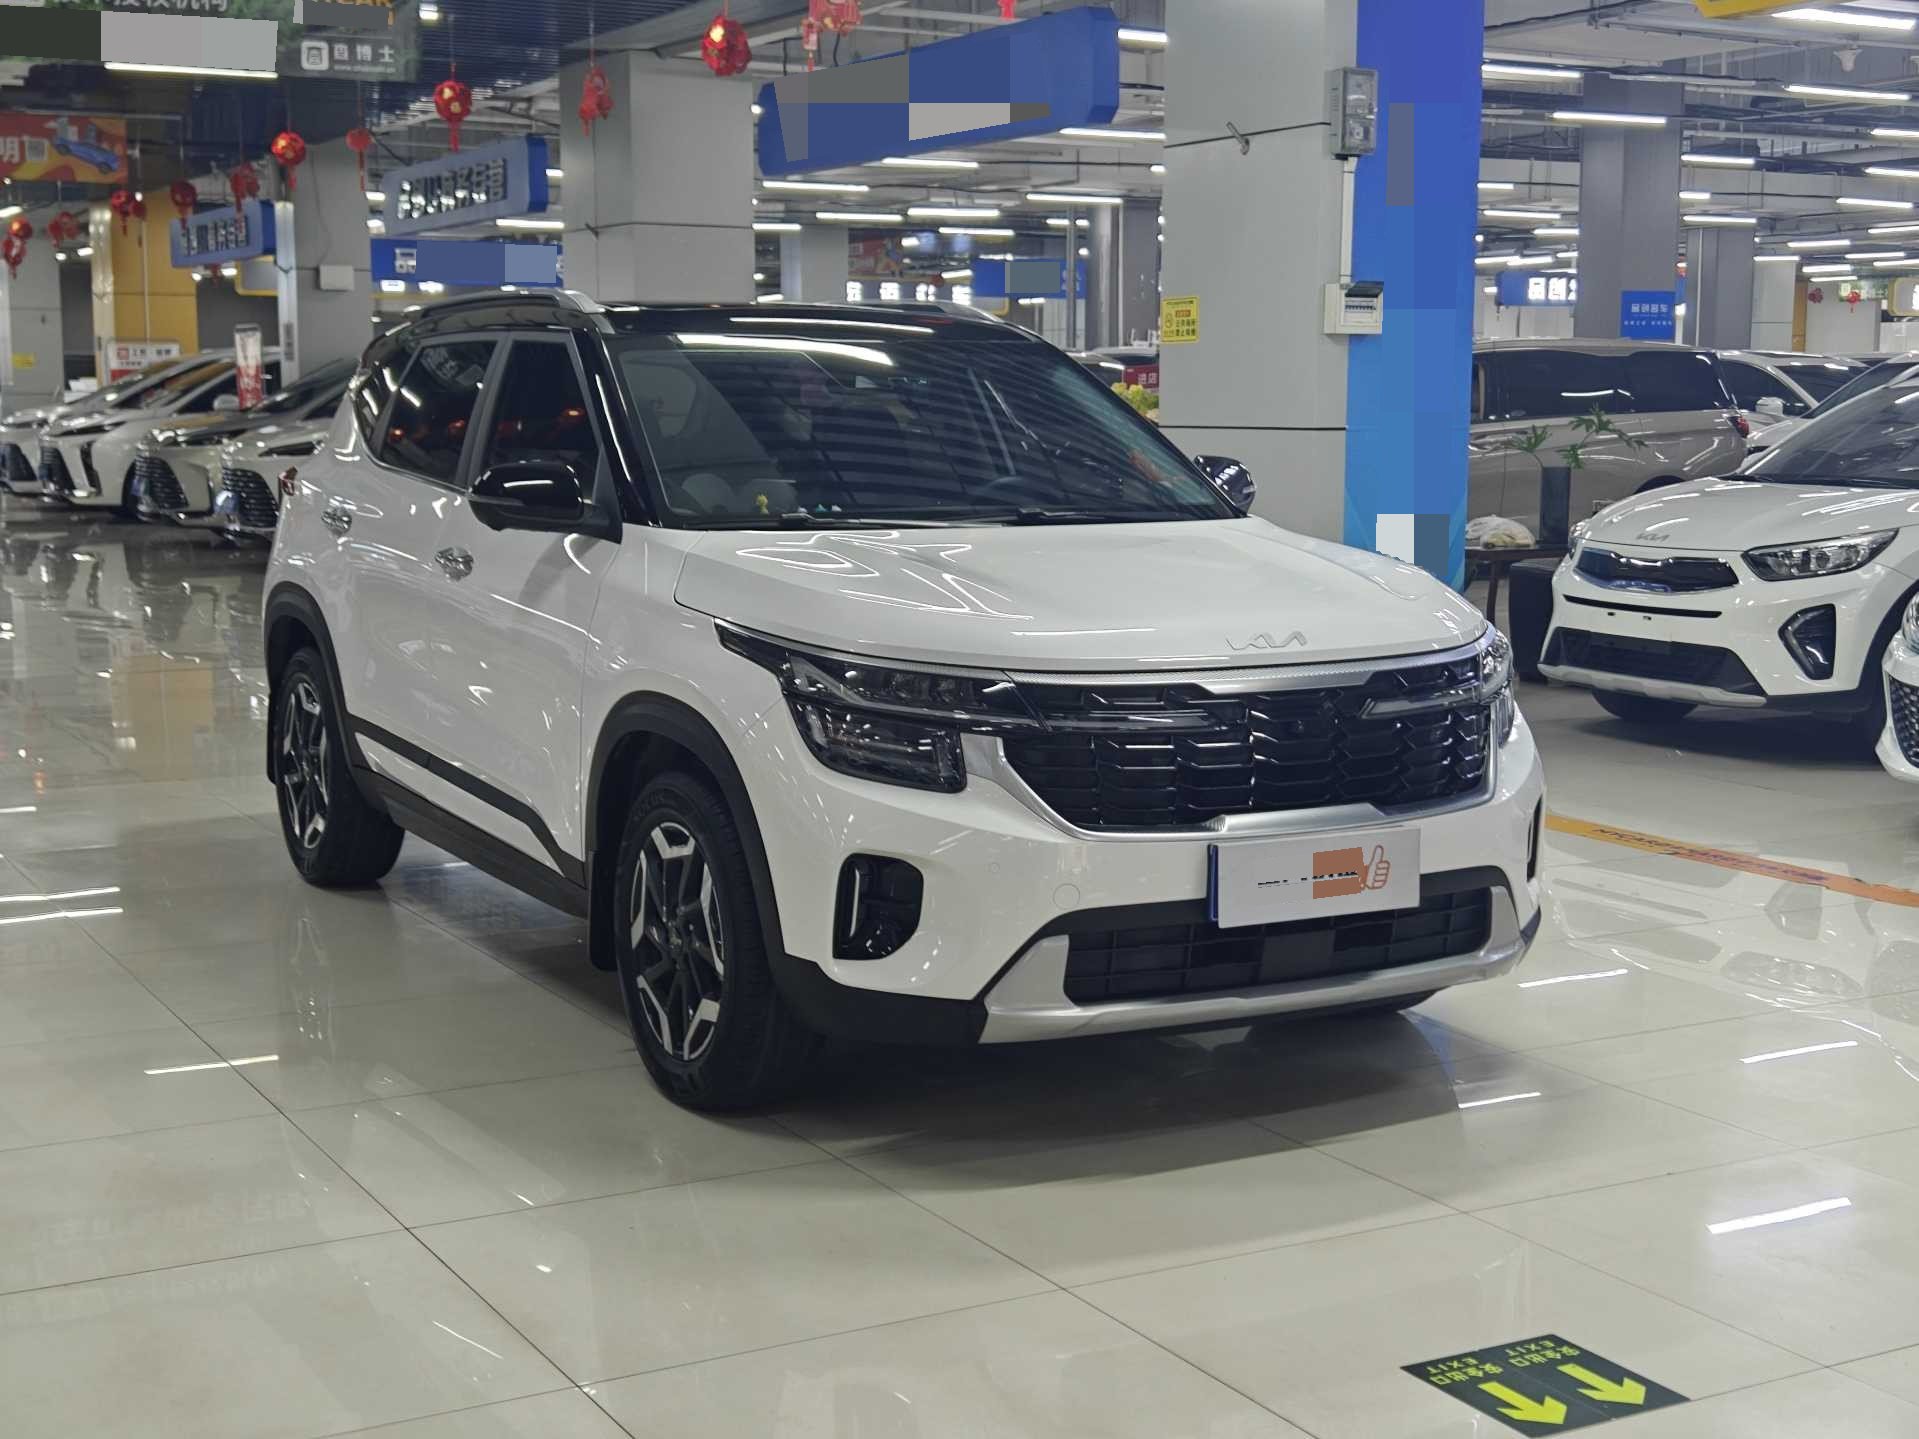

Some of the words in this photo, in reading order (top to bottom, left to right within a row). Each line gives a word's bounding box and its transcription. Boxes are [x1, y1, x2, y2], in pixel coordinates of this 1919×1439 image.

[1504, 1340, 1555, 1357] EXIT
[1508, 1345, 1581, 1368] 安全出口
[1426, 1357, 1479, 1374] EXIT
[1429, 1362, 1504, 1386] 安全出口
